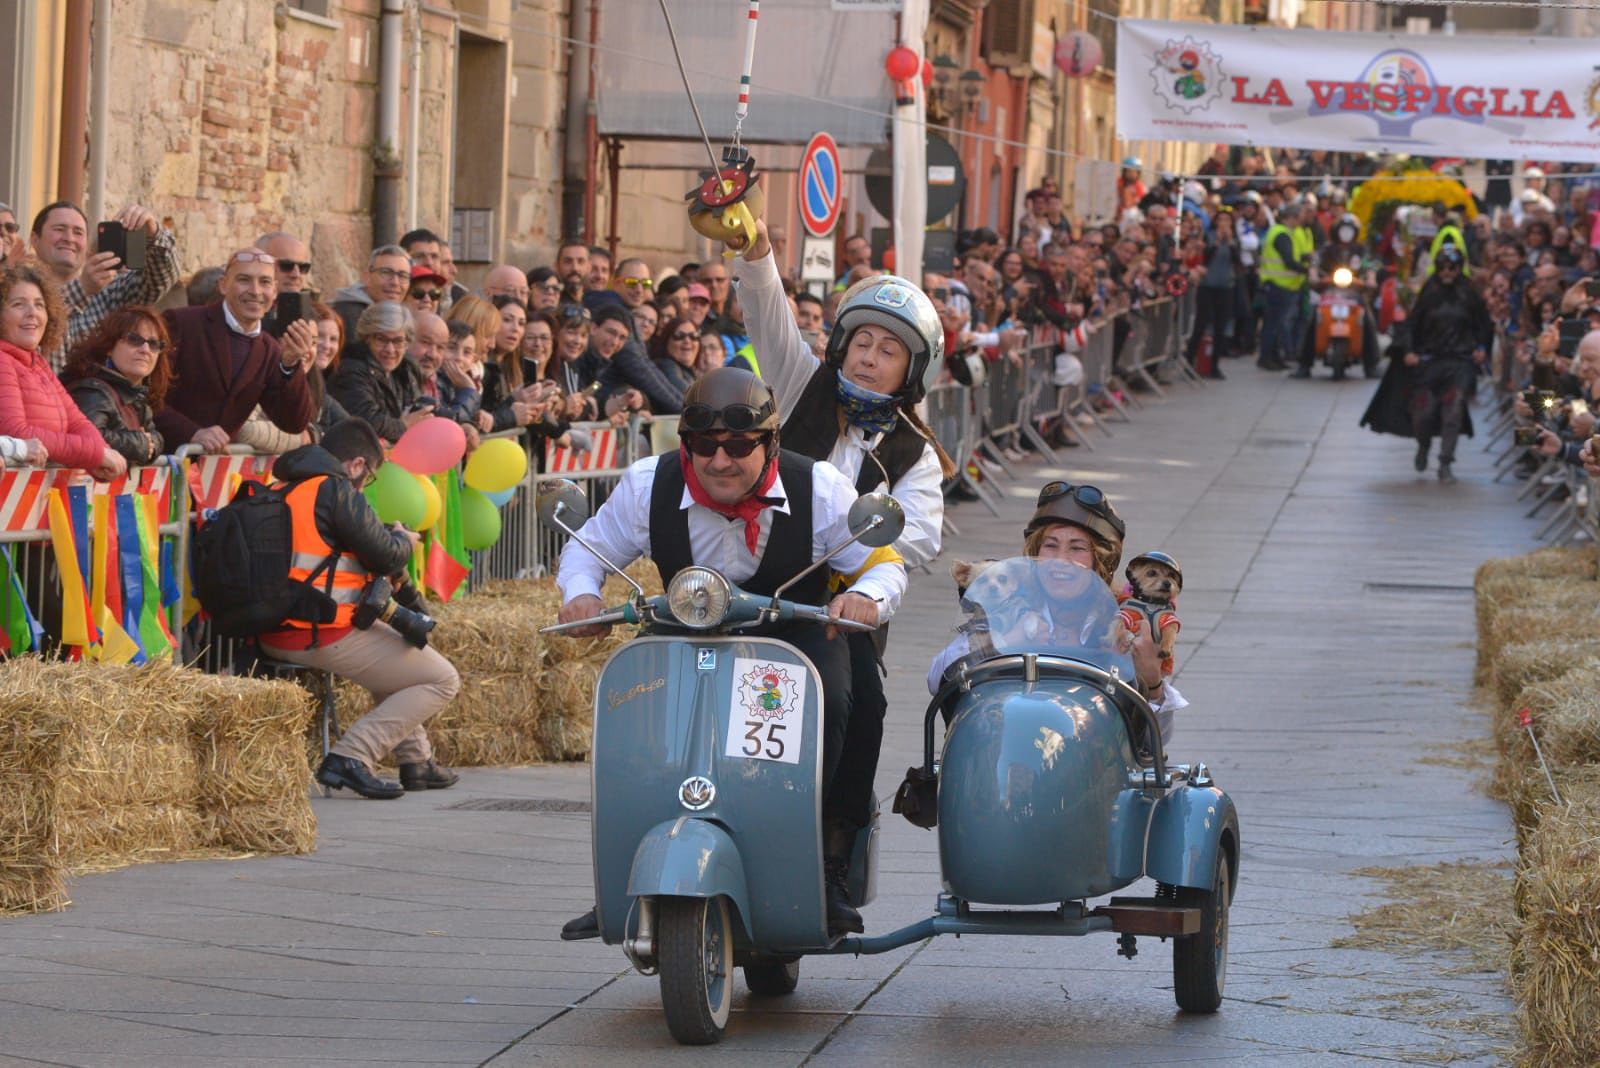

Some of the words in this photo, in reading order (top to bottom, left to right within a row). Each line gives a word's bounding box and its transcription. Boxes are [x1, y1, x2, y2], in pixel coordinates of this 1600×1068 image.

[1231, 76, 1293, 107] LA
[1306, 80, 1575, 119] VESPIGLIA
[749, 668, 791, 685] VESPIGLIA
[749, 704, 785, 718] CAGLIARI
[742, 721, 787, 760] 35
